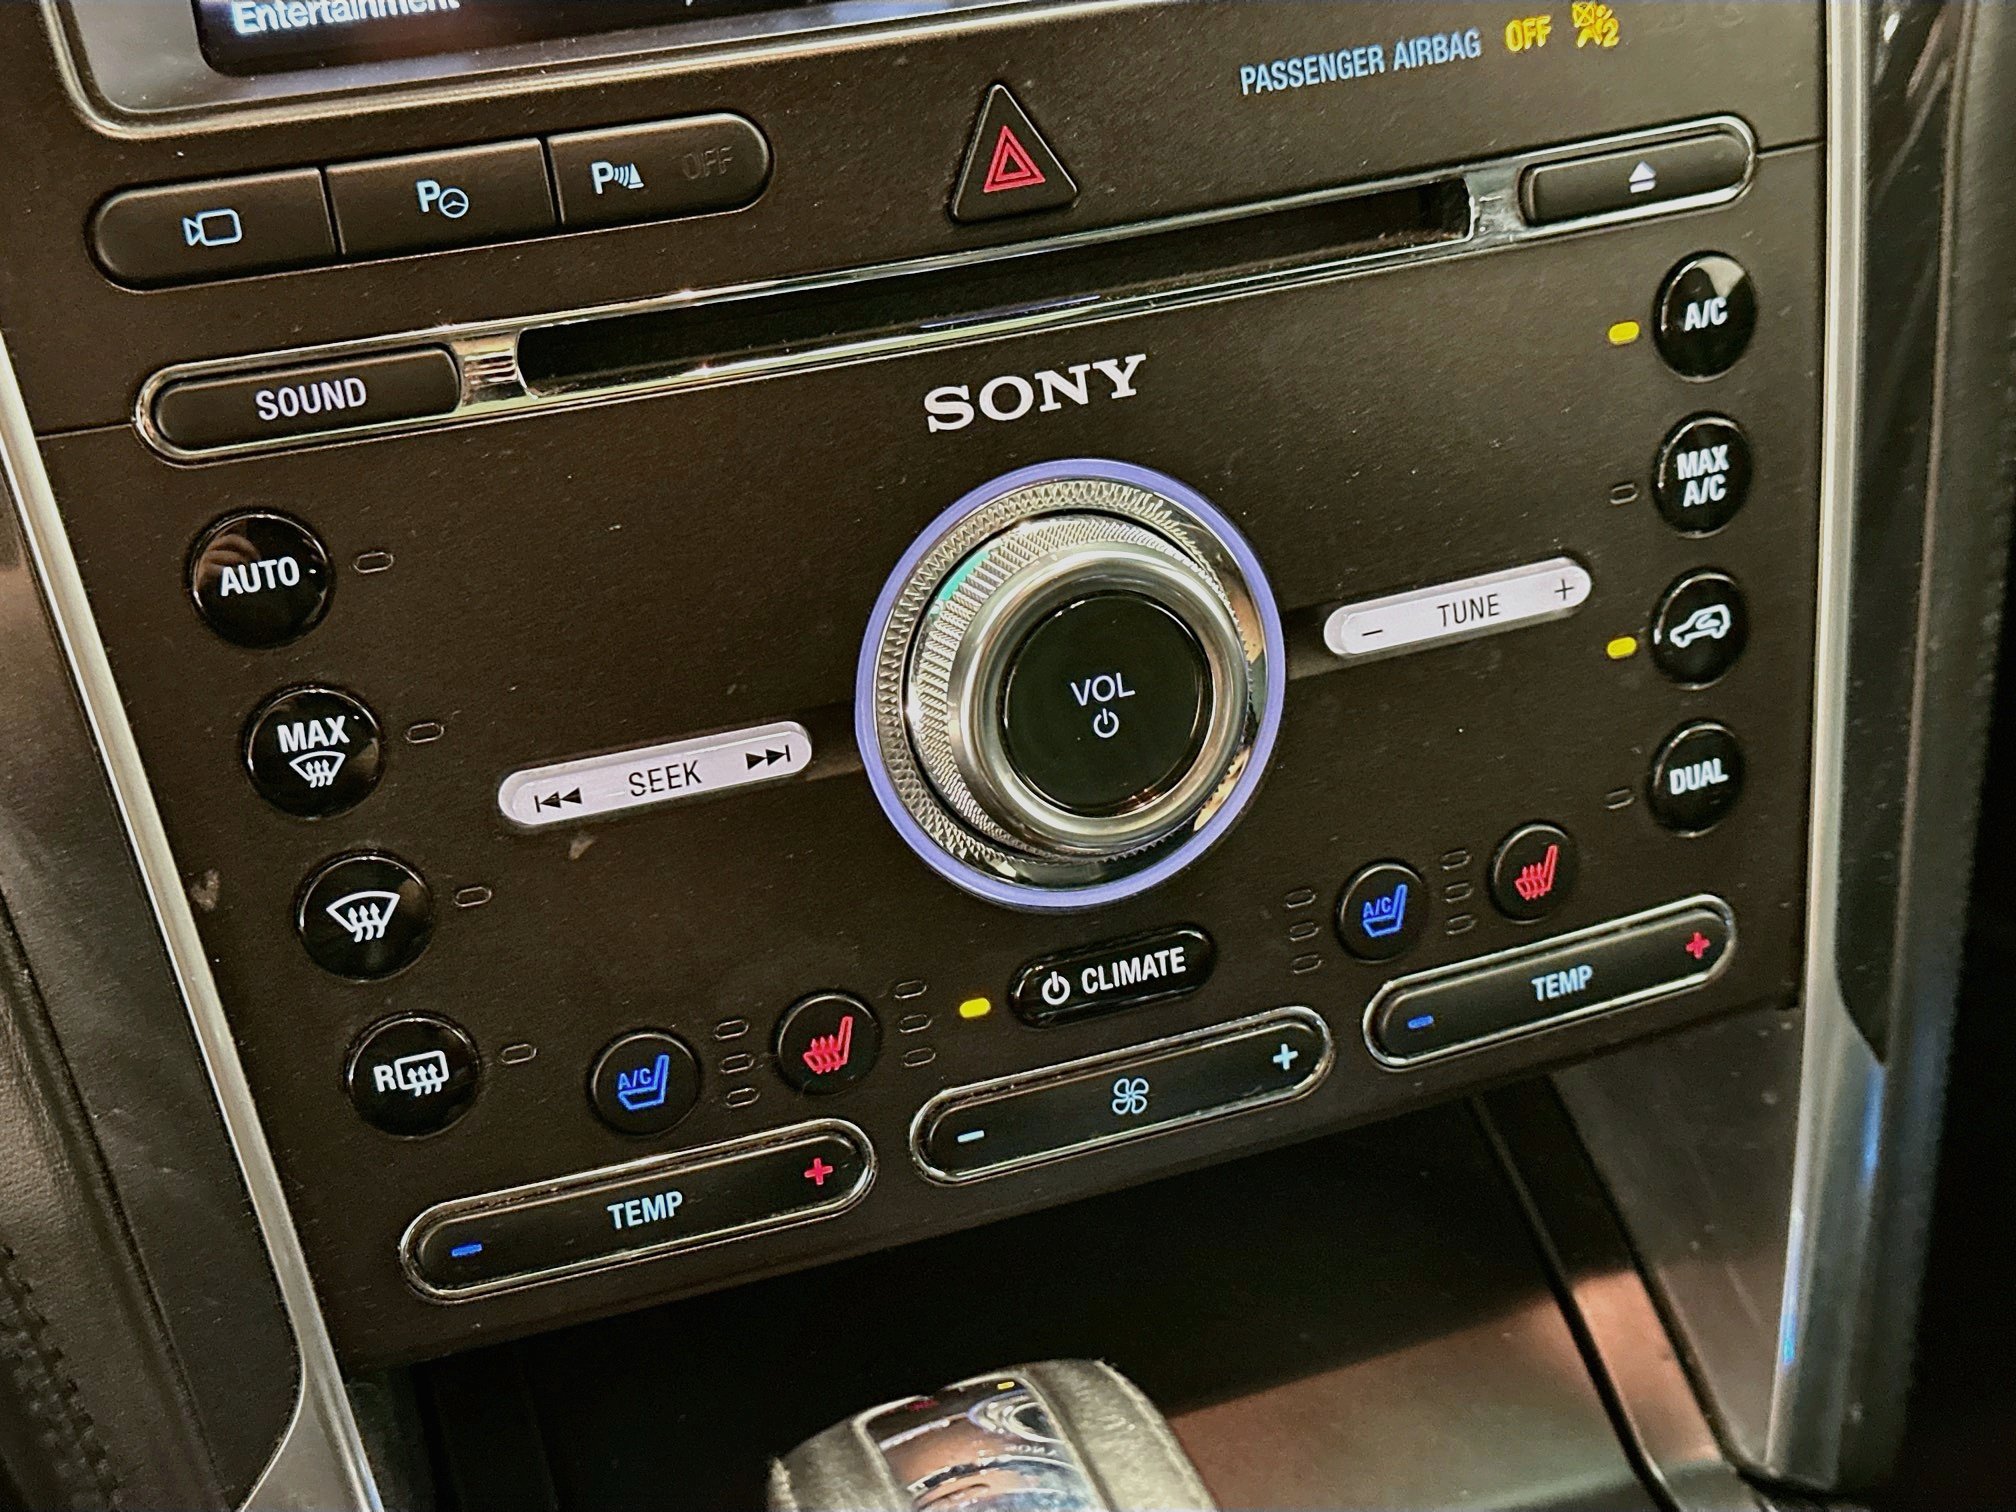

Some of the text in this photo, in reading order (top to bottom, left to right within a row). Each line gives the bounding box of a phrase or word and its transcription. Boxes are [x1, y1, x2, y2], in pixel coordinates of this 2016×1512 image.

[1240, 44, 1386, 96] PASSENGER
[1393, 27, 1482, 71] AIRBAG
[1504, 14, 1553, 53] OFF
[681, 146, 733, 180] OFF
[1684, 296, 1728, 332] A/C
[255, 376, 367, 421] SOUND
[925, 354, 1146, 434] SONY
[1676, 444, 1730, 481] MAX
[1682, 474, 1727, 508] A/C
[218, 555, 301, 597] AUTO
[1437, 593, 1500, 628] TUNE
[1071, 673, 1136, 706] VOL
[277, 716, 350, 752] MAX
[628, 759, 702, 797] SEEK
[1669, 757, 1730, 796] DUAL
[1362, 896, 1392, 919] A/C
[1081, 946, 1187, 996] CLIMATE
[1532, 964, 1593, 1002] TEMP
[372, 1064, 396, 1093] R
[617, 1067, 650, 1091] A/C
[606, 1190, 683, 1230] TEMP
